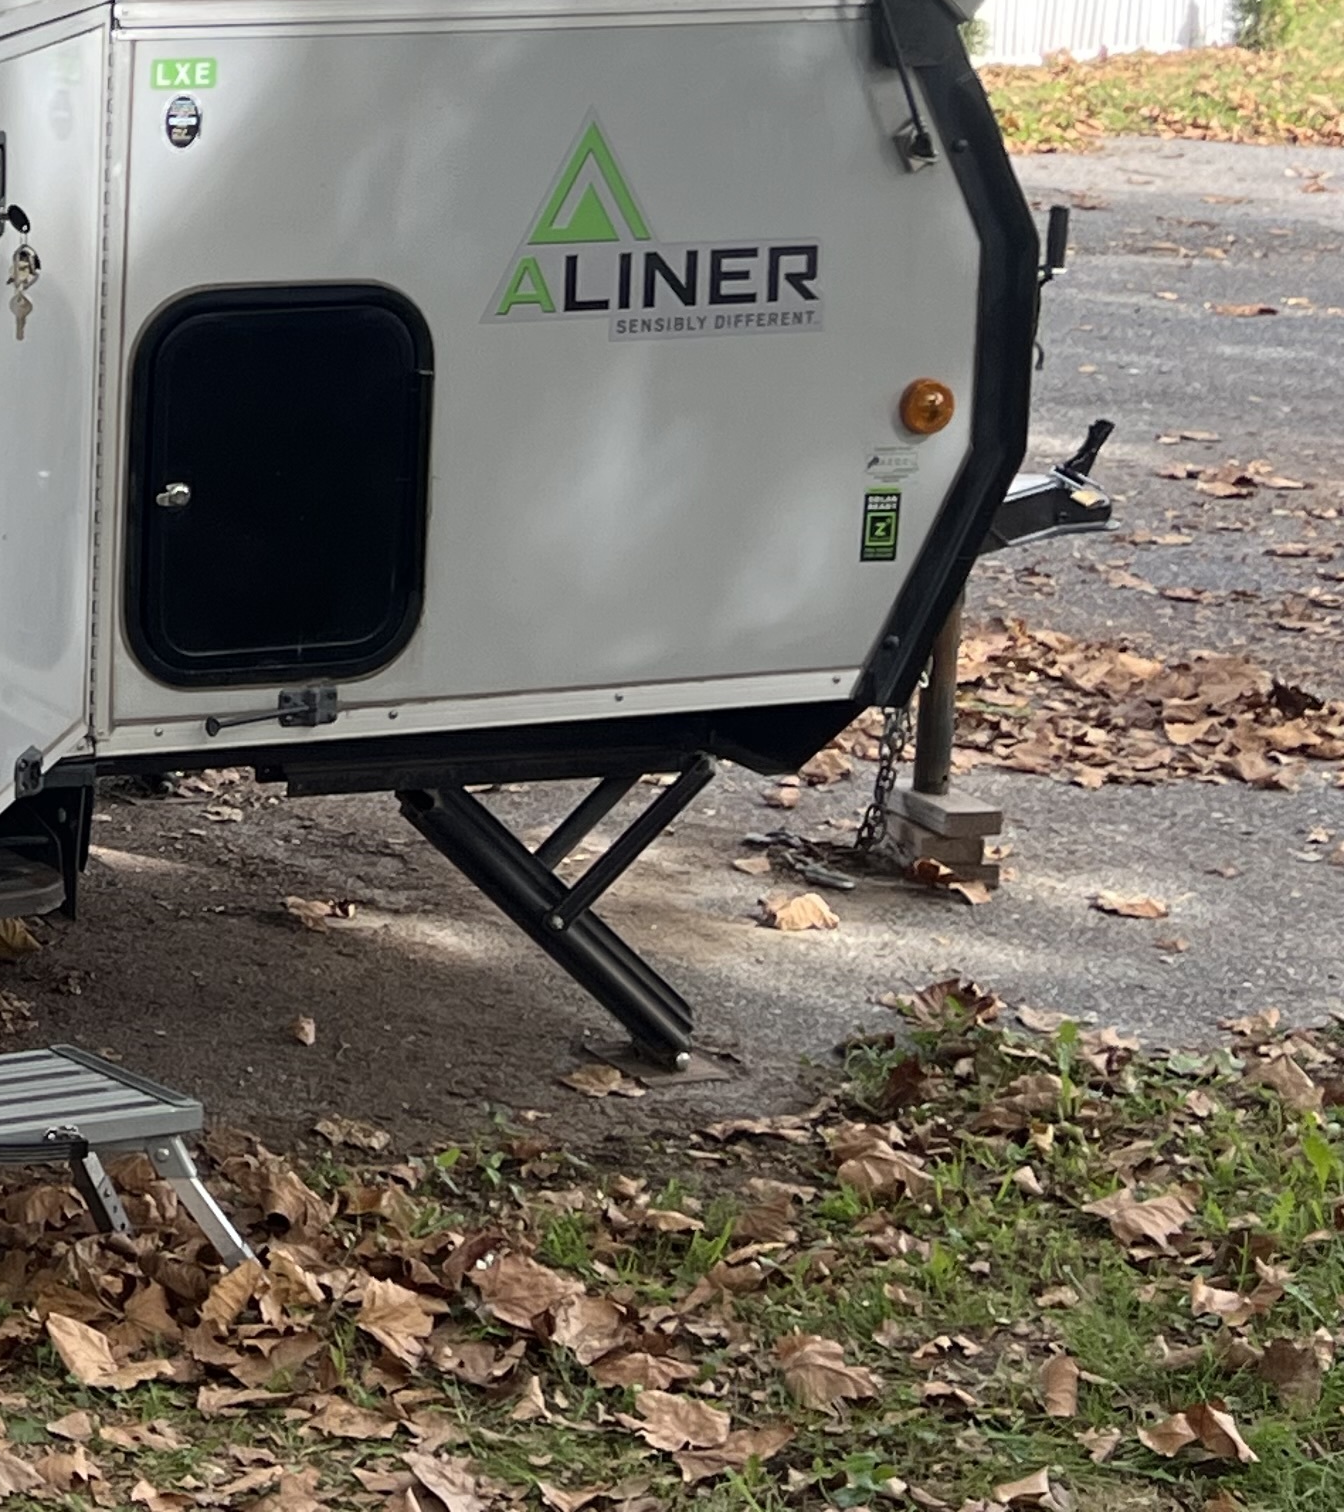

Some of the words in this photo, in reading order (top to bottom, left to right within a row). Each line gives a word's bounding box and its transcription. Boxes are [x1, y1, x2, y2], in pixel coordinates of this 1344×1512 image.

[155, 62, 211, 86] LXE
[495, 244, 820, 316] ALINER
[615, 315, 708, 335] SENSIBLY
